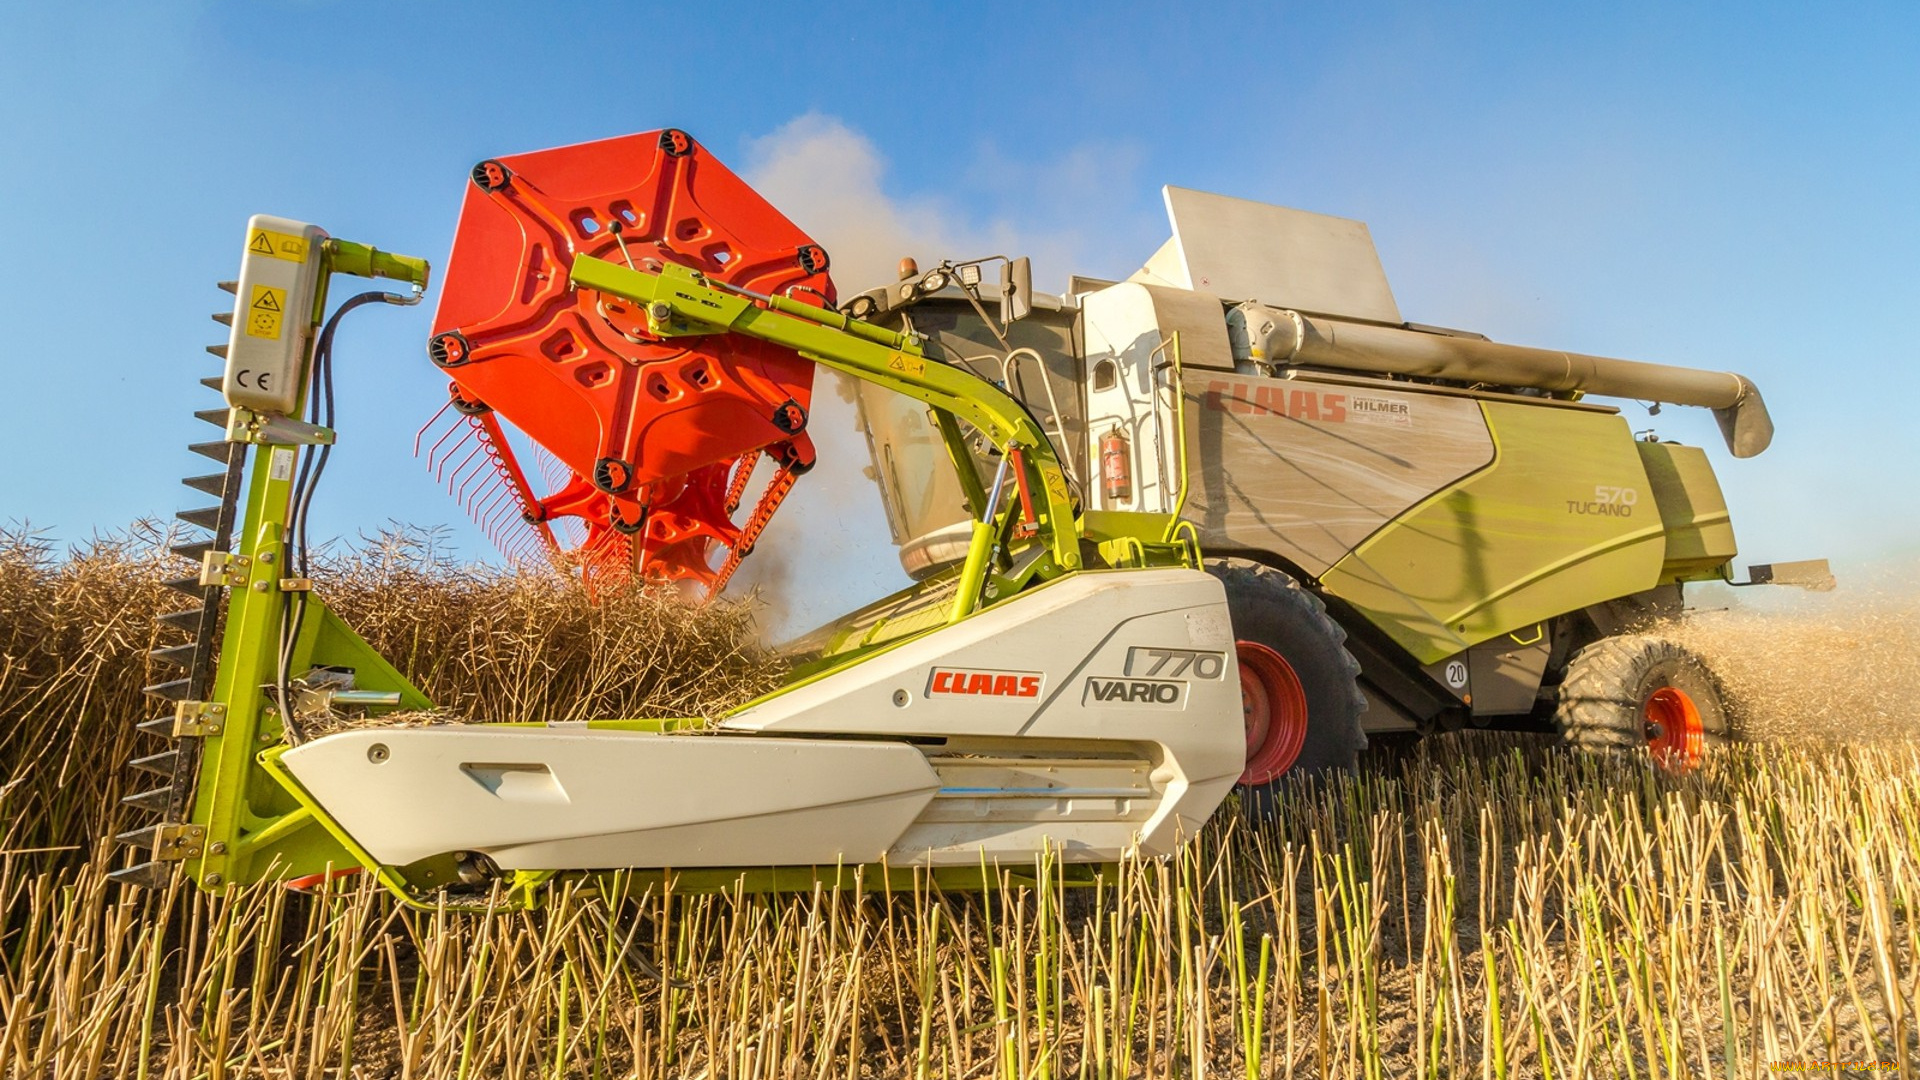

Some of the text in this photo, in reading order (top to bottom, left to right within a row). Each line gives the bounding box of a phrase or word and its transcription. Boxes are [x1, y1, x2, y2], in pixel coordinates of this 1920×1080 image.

[1206, 380, 1346, 423] CLAAS
[1353, 400, 1408, 414] HILMER
[1595, 485, 1637, 505] 570
[1566, 500, 1631, 517] TUCANO
[1145, 650, 1224, 680] 770
[1449, 664, 1464, 682] 20
[932, 672, 1040, 697] CLAAS
[1091, 681, 1179, 704] VARIO
